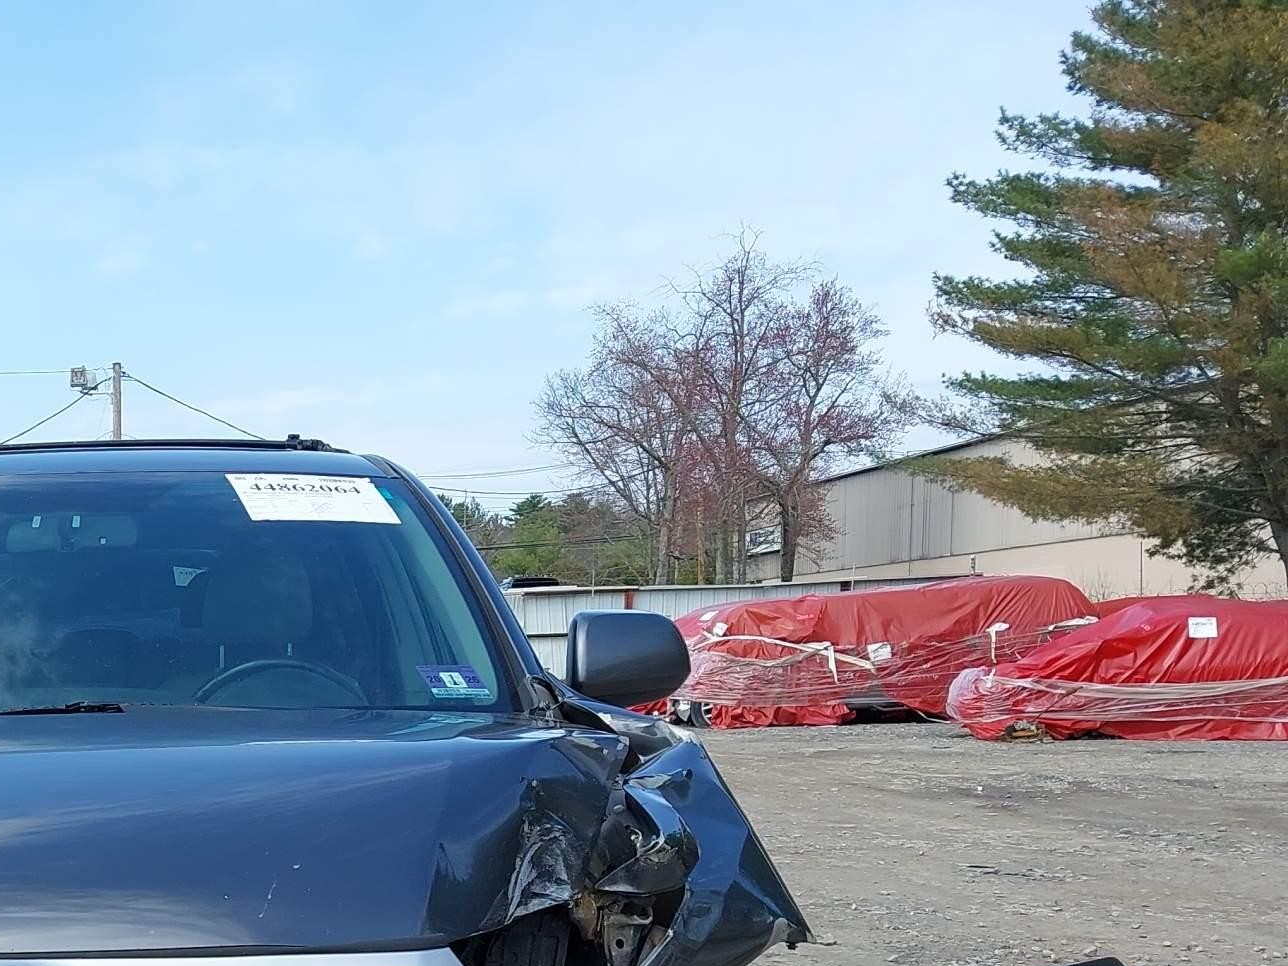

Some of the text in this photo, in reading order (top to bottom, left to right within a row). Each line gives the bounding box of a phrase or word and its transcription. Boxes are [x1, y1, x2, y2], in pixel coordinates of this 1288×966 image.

[250, 483, 361, 494] 44862064
[426, 674, 442, 684] 20
[447, 674, 460, 686] 1
